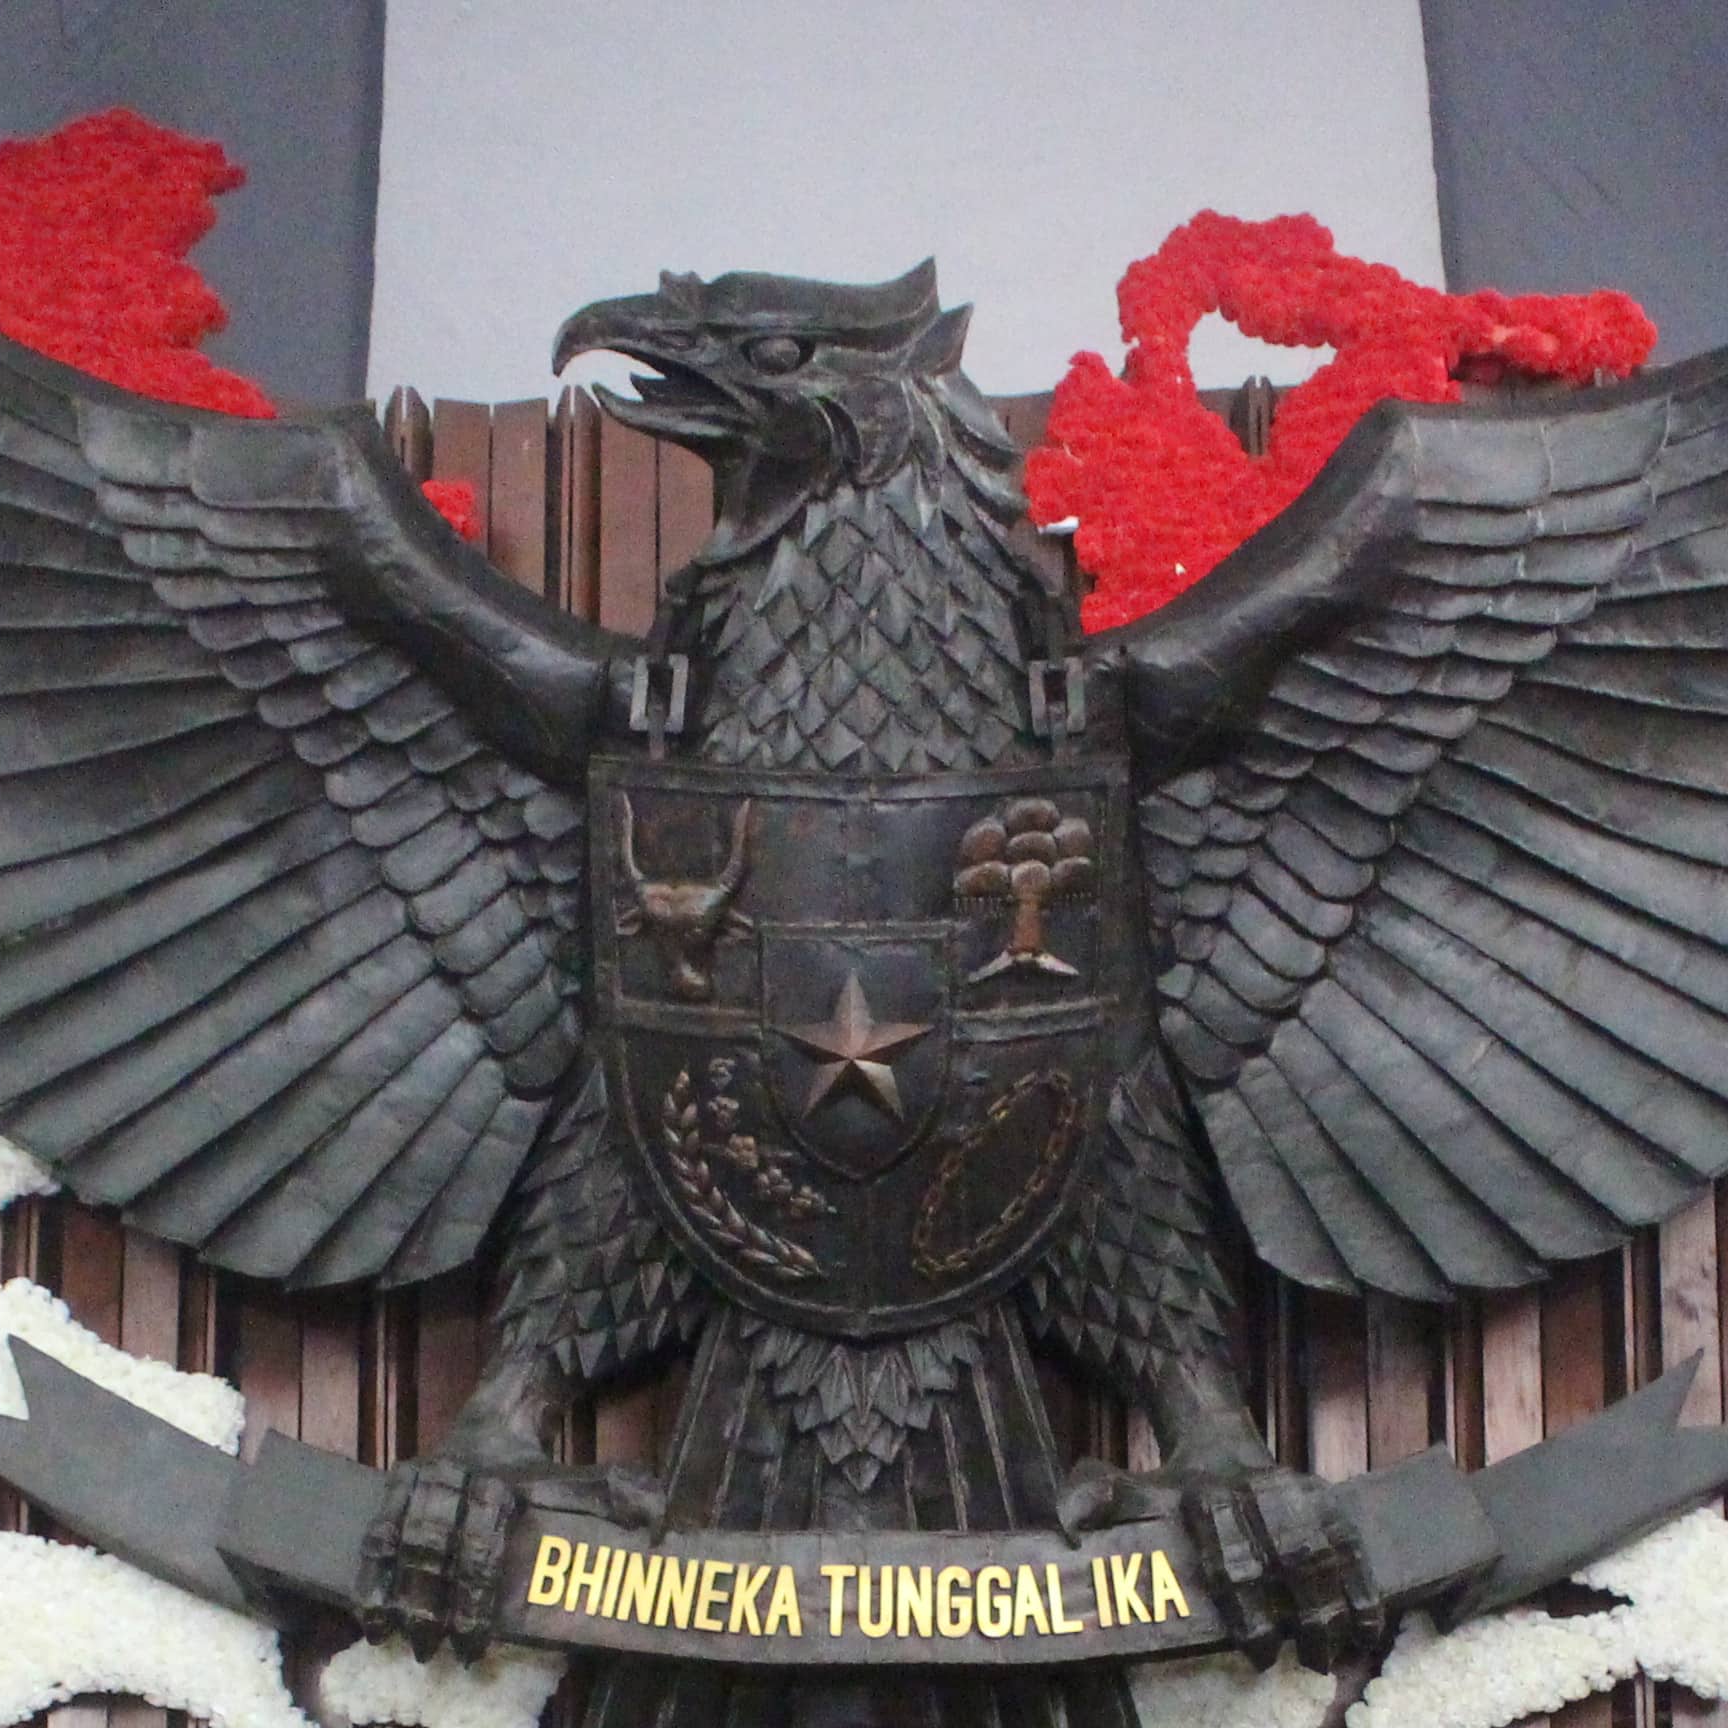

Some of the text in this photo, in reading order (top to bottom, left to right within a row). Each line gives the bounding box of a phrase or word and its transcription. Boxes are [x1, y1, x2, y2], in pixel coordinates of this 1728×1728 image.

[527, 1535, 1190, 1638] BHINNEKA TUNGGAL IKA
